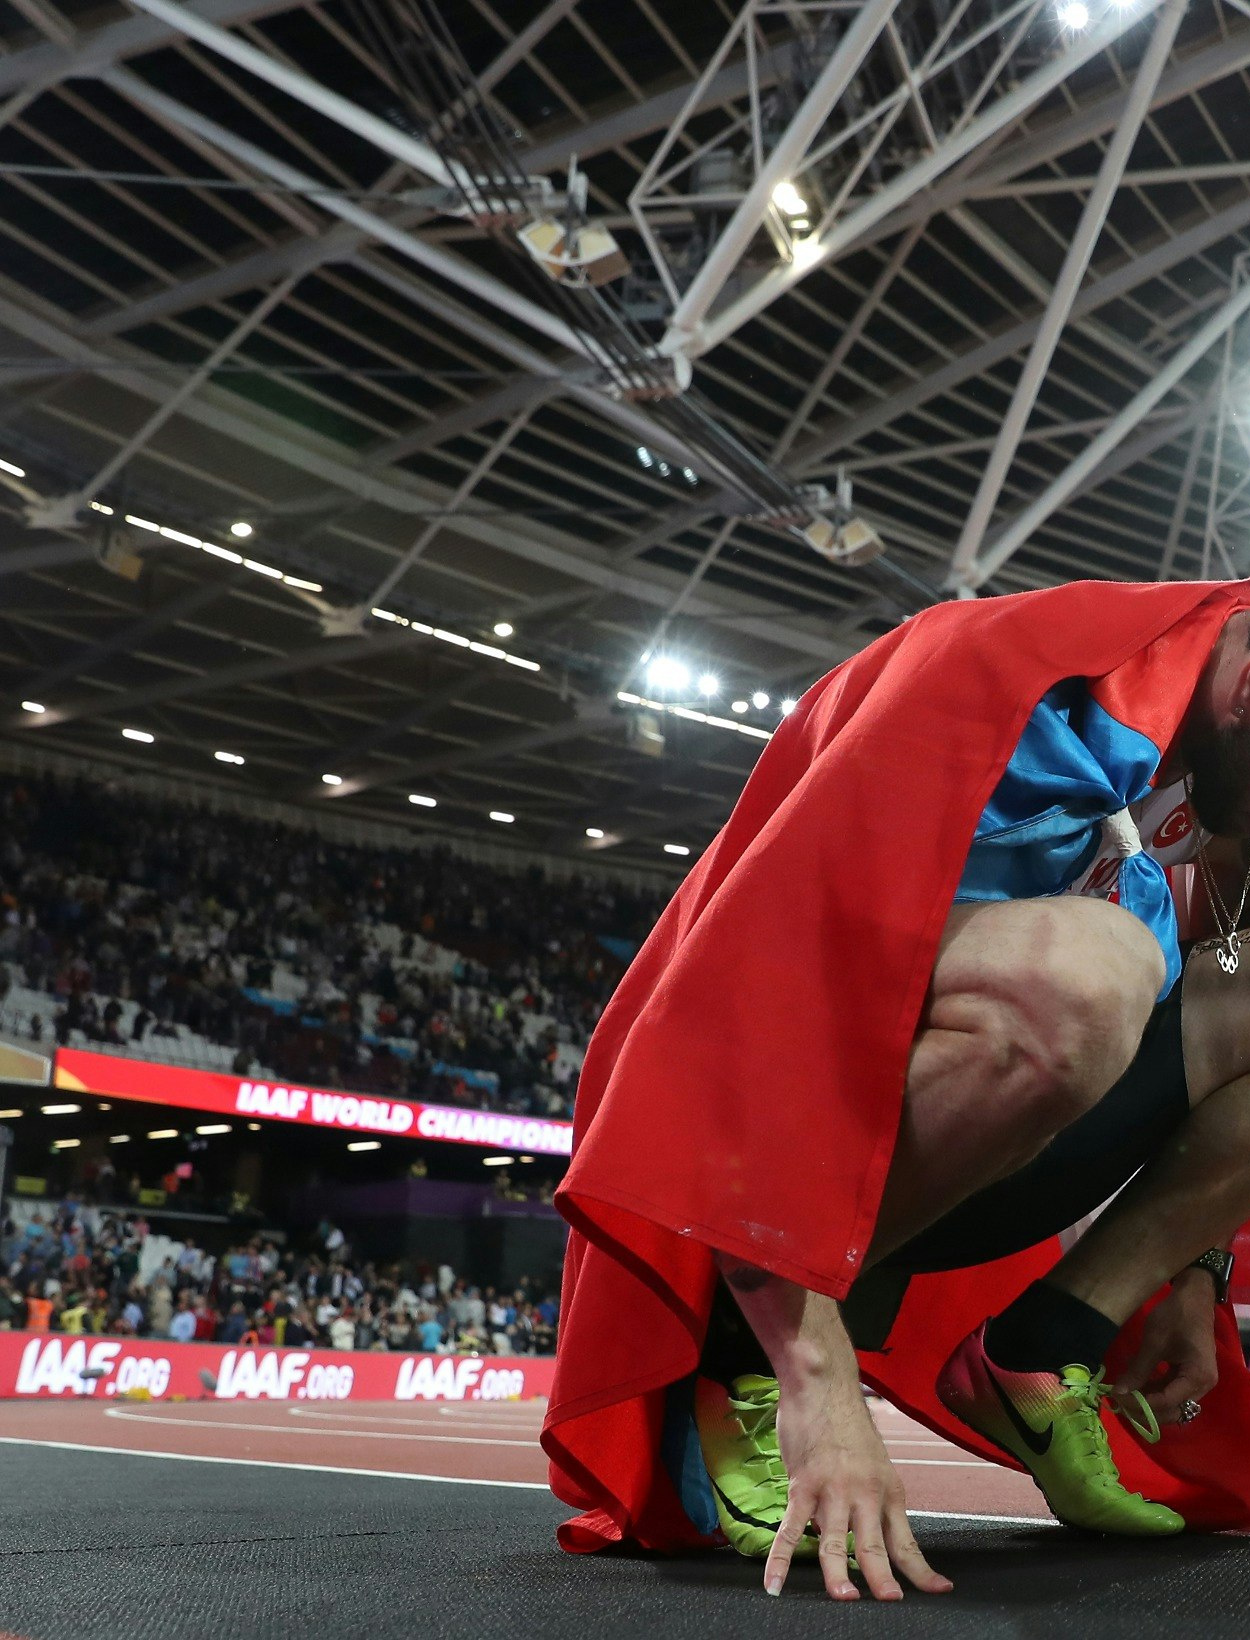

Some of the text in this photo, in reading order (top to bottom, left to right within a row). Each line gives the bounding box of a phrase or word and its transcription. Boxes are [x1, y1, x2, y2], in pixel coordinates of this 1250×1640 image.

[235, 1081, 308, 1119] IAAF
[311, 1092, 413, 1133] WORLD
[15, 1337, 171, 1397] IAAF.ORG
[215, 1350, 354, 1400] IAAF.ORG
[394, 1357, 525, 1400] IAAF.ORG
